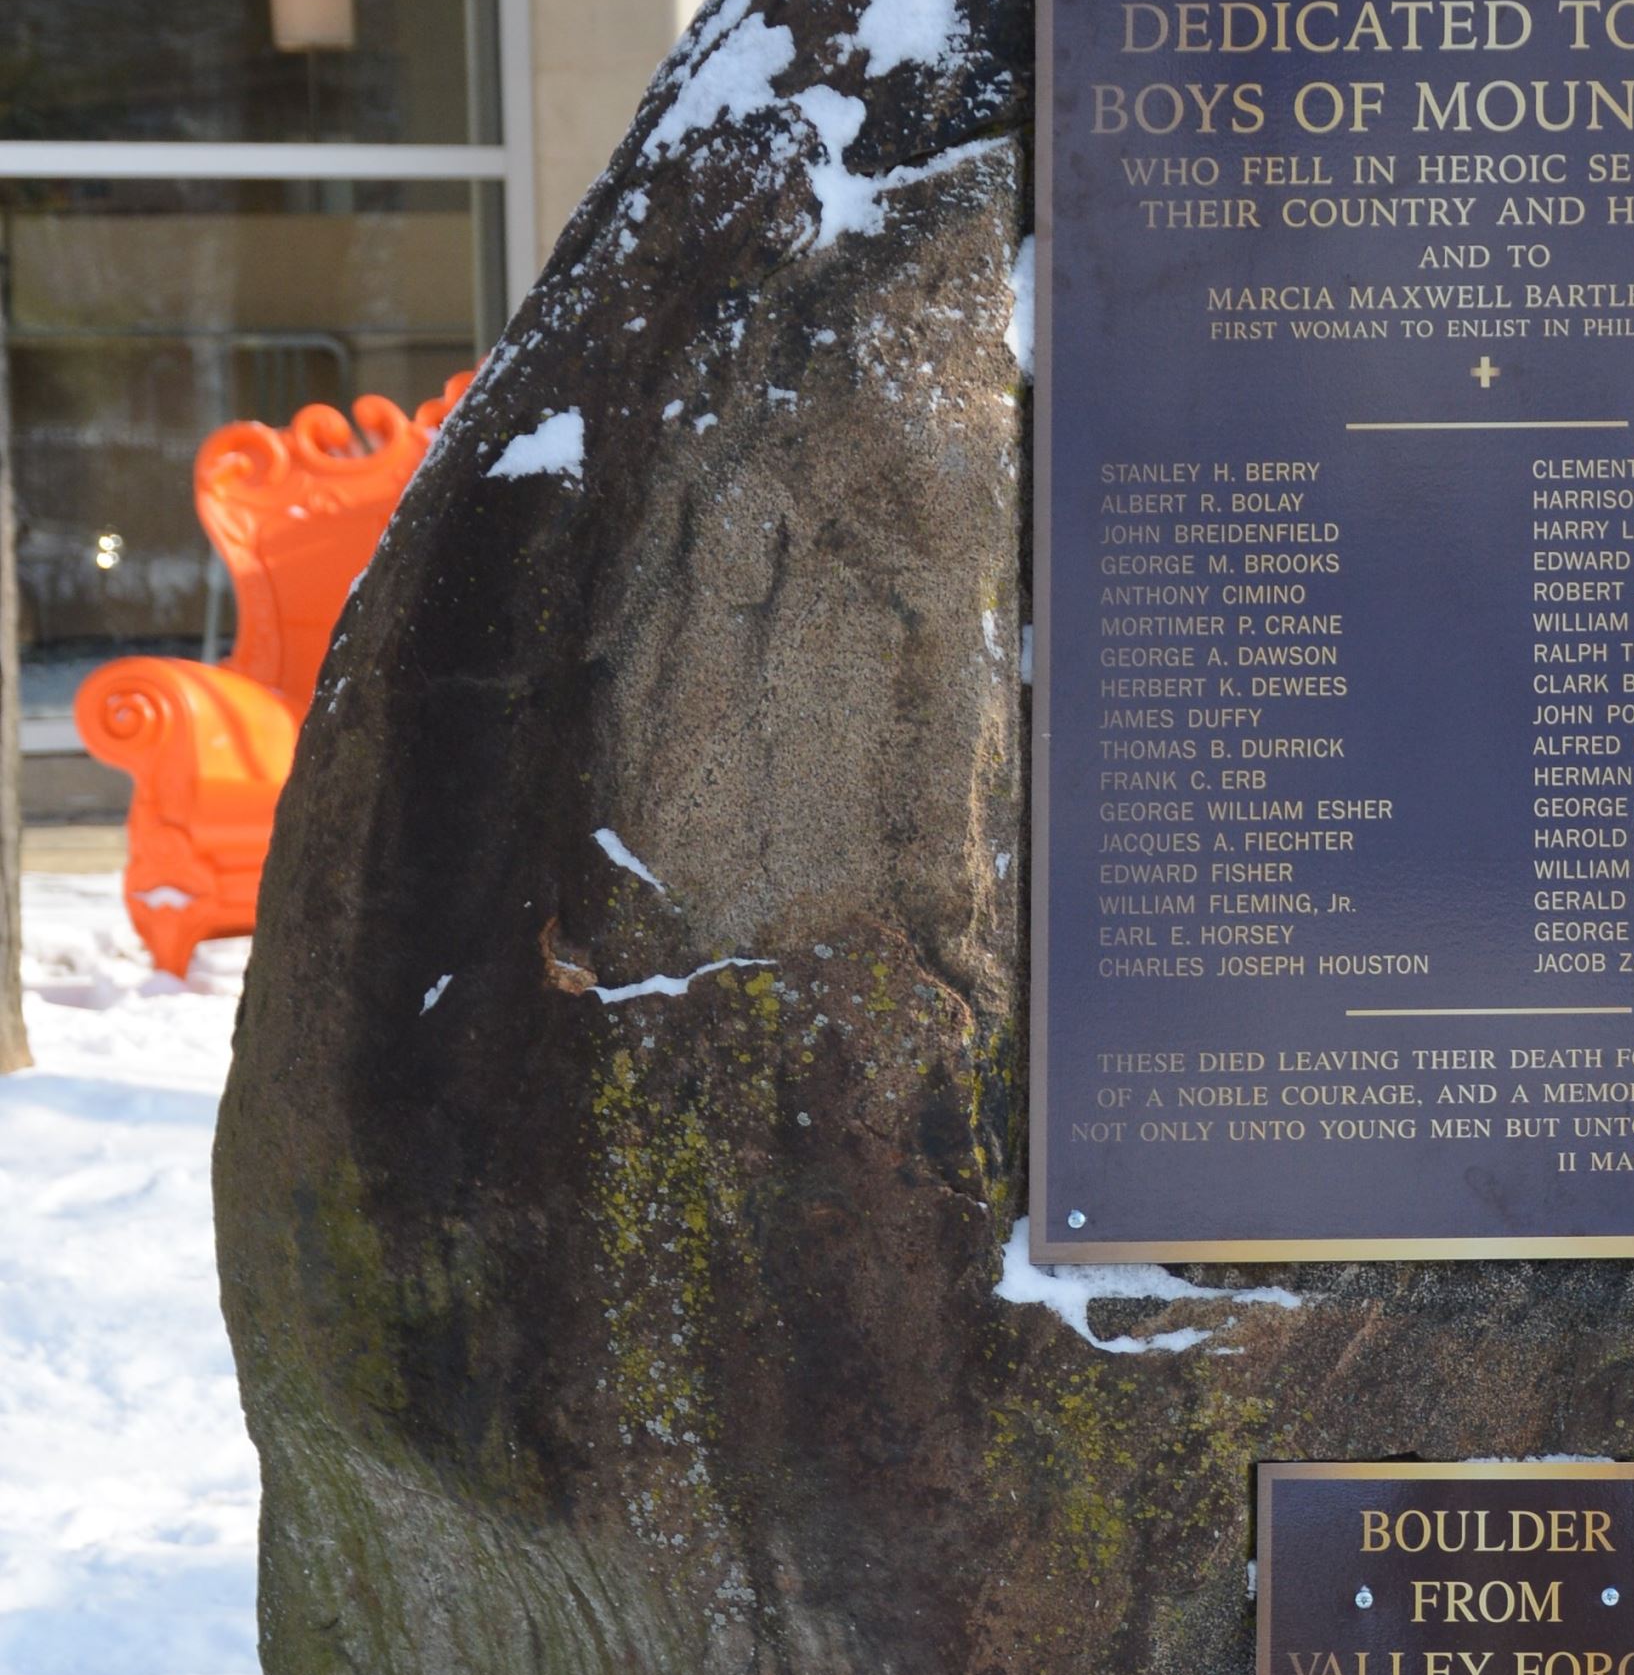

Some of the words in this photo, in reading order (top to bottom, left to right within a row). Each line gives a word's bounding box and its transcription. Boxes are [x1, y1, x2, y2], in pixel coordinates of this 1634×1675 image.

[1122, 0, 1532, 52] DEDICATED
[1092, 83, 1264, 134] BOYS
[1296, 82, 1384, 133] OF
[1121, 157, 1219, 186] WHO
[1242, 157, 1332, 185] FELL
[1353, 156, 1396, 184] IN
[1419, 154, 1566, 183] HEROIC
[1140, 200, 1261, 228] THEIR
[1282, 198, 1476, 227] COUNTRY
[1496, 197, 1585, 225] AND
[1418, 246, 1490, 268] AND
[1507, 245, 1550, 268] TO
[1208, 287, 1334, 310] MARCIA
[1349, 285, 1512, 309] MAXWELL
[1211, 321, 1277, 339] FIRST
[1290, 321, 1388, 339] WOMAN
[1401, 320, 1433, 338] TO
[1448, 319, 1530, 337] ENLIST
[1544, 319, 1569, 336] IN
[1102, 463, 1200, 483] STANLEY
[1215, 463, 1235, 482] H.
[1246, 462, 1320, 481] BERRY
[1101, 494, 1187, 513] ALBERT
[1201, 494, 1221, 512] R.
[1232, 493, 1304, 512] BOLAY
[1101, 525, 1160, 544] JOHN
[1175, 523, 1339, 543] BREIDENFIELD
[1534, 521, 1609, 540] HARRY
[1101, 555, 1194, 574] GEORGE
[1209, 555, 1234, 573] M.
[1245, 554, 1339, 573] BROOKS
[1534, 551, 1630, 571] EDWARD
[1101, 585, 1210, 605] ANTHONY
[1223, 585, 1305, 604] CIMINO
[1534, 582, 1624, 601] ROBERT
[1102, 616, 1224, 636] MORTIMER
[1239, 616, 1255, 635] P.
[1266, 615, 1342, 635] CRANE
[1533, 612, 1628, 632] WILLIAM
[1101, 647, 1194, 667] GEORGE
[1208, 647, 1228, 666] A.
[1239, 646, 1336, 665] DAWSON
[1534, 643, 1607, 662] RALPH
[1102, 678, 1206, 697] HERBERT
[1220, 678, 1241, 697] K.
[1252, 677, 1347, 696] DEWEES
[1534, 674, 1608, 694] CLARK
[1100, 709, 1174, 728] JAMES
[1189, 708, 1262, 728] DUFFY
[1533, 705, 1592, 725] JOHN
[1100, 740, 1196, 759] THOMAS
[1211, 740, 1231, 758] B.
[1242, 738, 1344, 758] DURRICK
[1533, 736, 1620, 755] ALFRED
[1101, 771, 1177, 790] FRANK
[1191, 771, 1211, 790] C.
[1222, 770, 1266, 789] ERB
[1535, 766, 1631, 786] HERMAN
[1100, 802, 1194, 821] GEORGE
[1208, 801, 1302, 820] WILLIAM
[1318, 800, 1392, 819] ESHER
[1534, 798, 1628, 817] GEORGE
[1099, 833, 1200, 856] JACQUES
[1214, 832, 1234, 851] A.
[1245, 831, 1353, 851] FIECHTER
[1535, 829, 1627, 848] HAROLD
[1101, 864, 1197, 883] EDWARD
[1212, 863, 1293, 882] FISHER
[1534, 859, 1629, 879] WILLIAM
[1099, 895, 1195, 914] WILLIAM
[1210, 893, 1318, 915] FLEMING,
[1534, 891, 1625, 910] GERALD
[1100, 926, 1157, 946] EARL
[1171, 926, 1190, 945] E.
[1202, 925, 1294, 945] HORSEY
[1535, 922, 1629, 941] GEORGE
[1099, 957, 1204, 977] CHARLES
[1217, 956, 1304, 976] JOSEPH
[1320, 955, 1428, 975] HOUSTON
[1534, 953, 1606, 972] JACOB
[1098, 1053, 1185, 1073] THESE
[1199, 1053, 1264, 1072] DIED
[1279, 1051, 1399, 1071] LEAVING
[1412, 1050, 1496, 1069] THEIR
[1510, 1049, 1602, 1068] DEATH
[1097, 1088, 1133, 1108] OF
[1146, 1088, 1164, 1107] A
[1178, 1087, 1268, 1106] NOBLE
[1282, 1085, 1422, 1106] COURAGE,
[1437, 1085, 1497, 1103] AND
[1511, 1084, 1529, 1103] A
[1072, 1122, 1127, 1142] NOT
[1140, 1121, 1213, 1141] ONLY
[1229, 1121, 1305, 1140] UNTO
[1320, 1119, 1416, 1139] YOUNG
[1431, 1119, 1491, 1138] MEN
[1506, 1118, 1560, 1137] BUT
[1558, 1153, 1576, 1171] II
[1360, 1510, 1616, 1552] BOULDER
[1411, 1581, 1563, 1623] FROM
